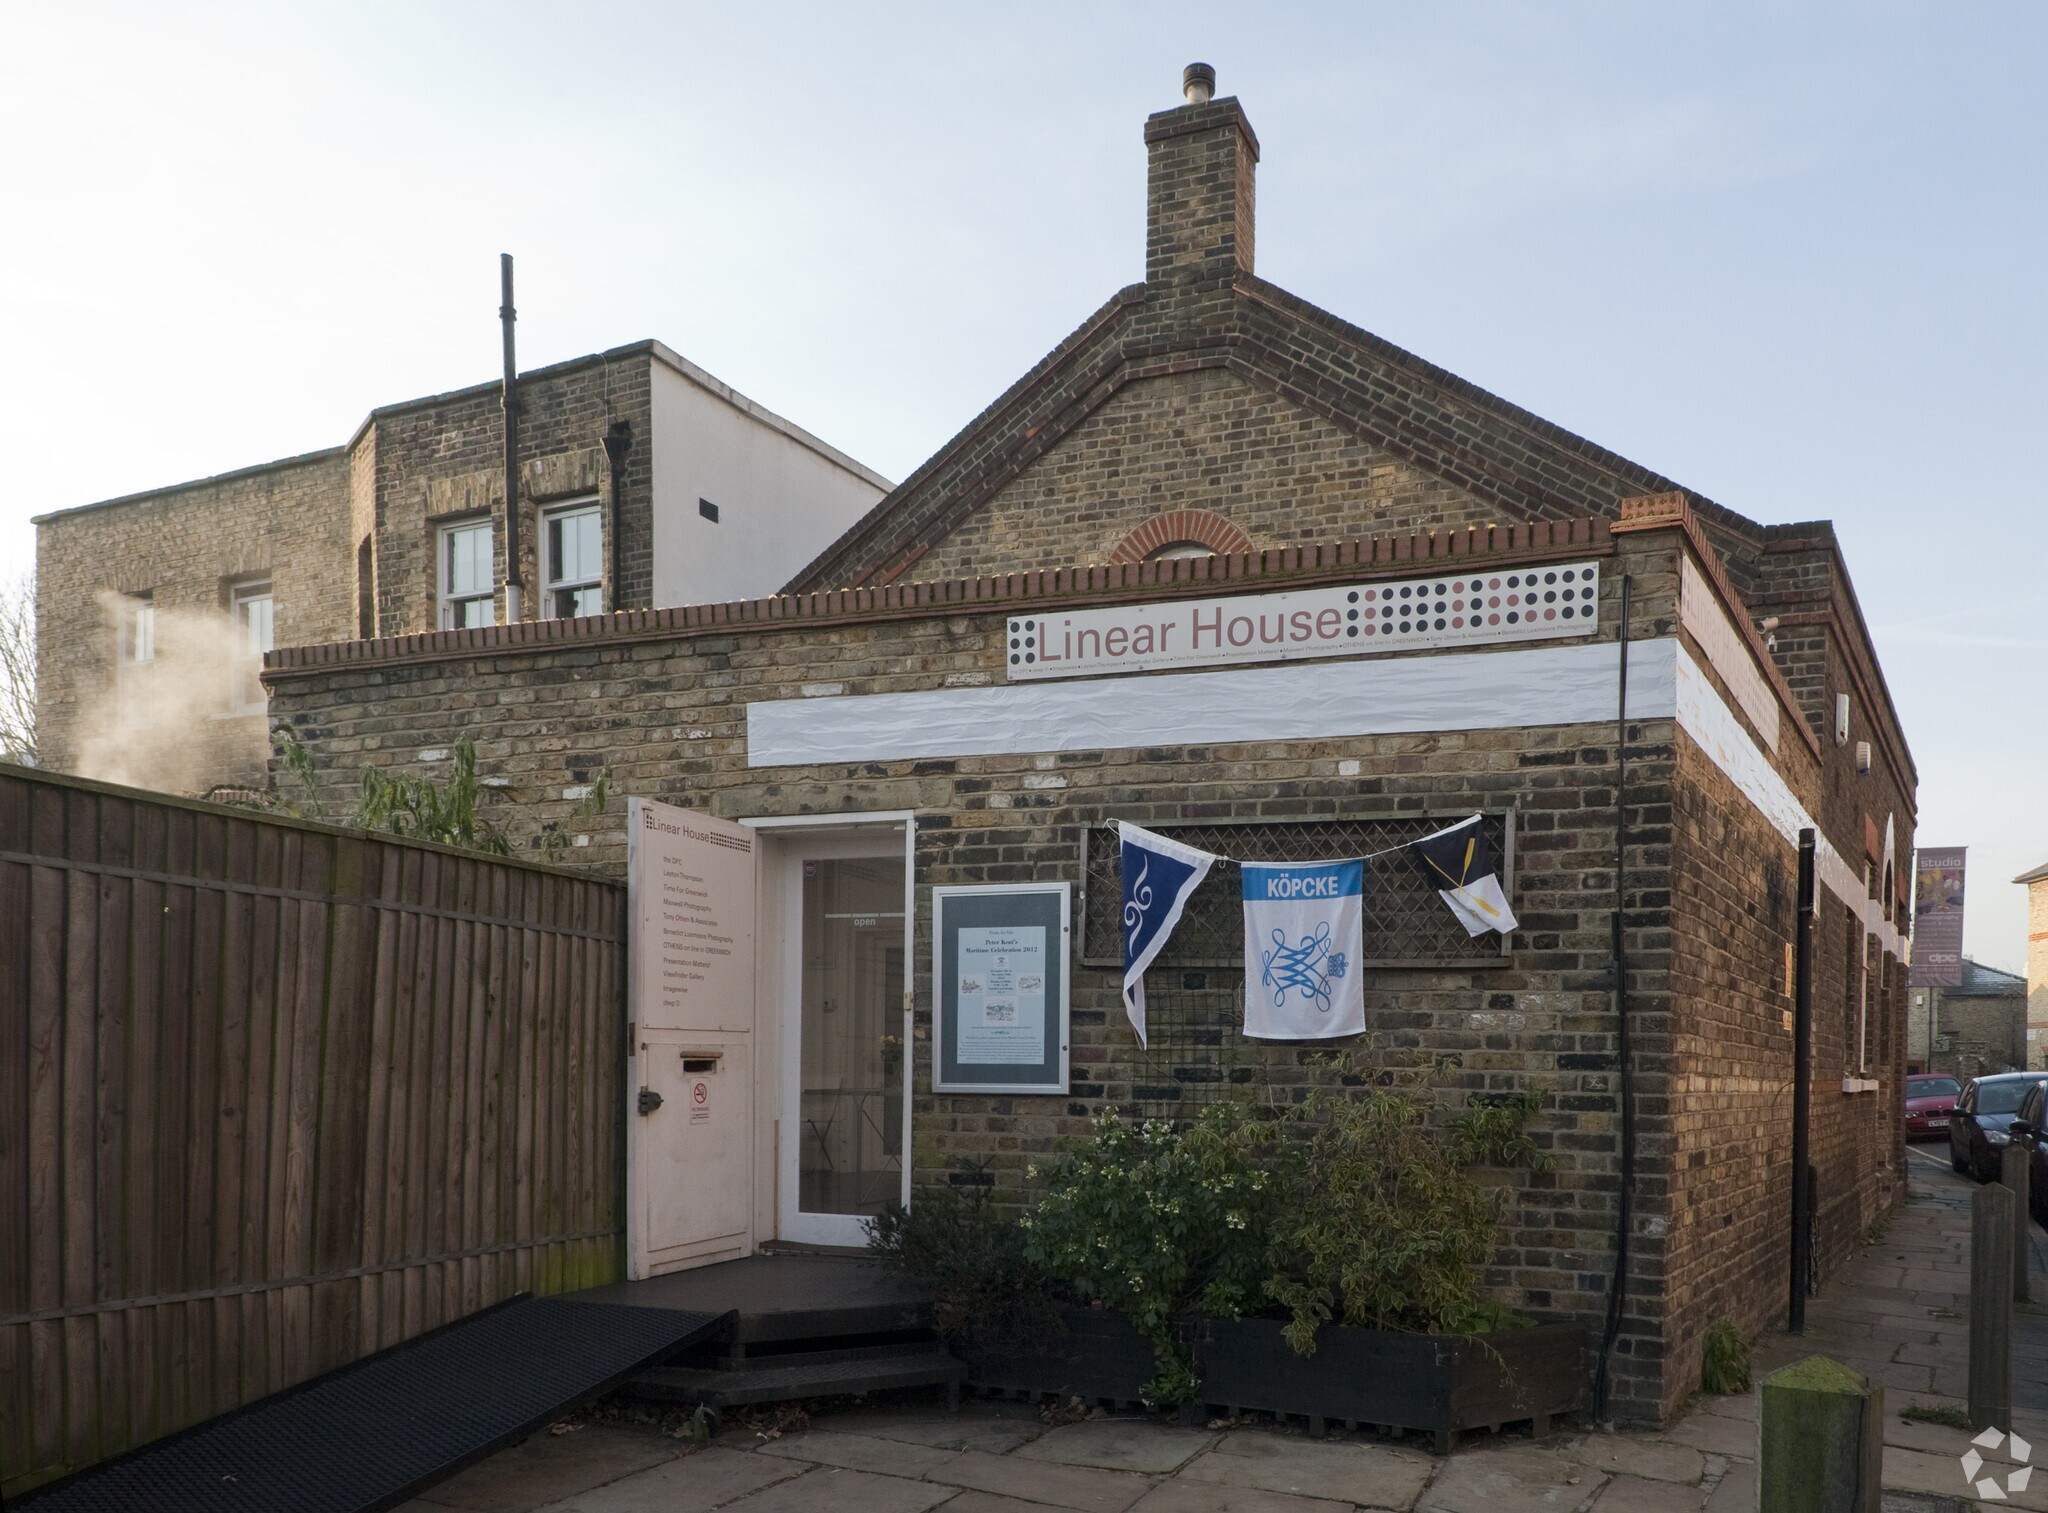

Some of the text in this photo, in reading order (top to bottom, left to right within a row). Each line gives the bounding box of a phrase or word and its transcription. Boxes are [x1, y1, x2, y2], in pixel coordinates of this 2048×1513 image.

[1039, 607, 1342, 662] Linear House
[652, 818, 710, 842] Linear House
[1920, 857, 1961, 868] studio
[1267, 872, 1339, 898] KÖPCKE
[854, 917, 876, 927] open
[663, 927, 684, 936] Benedict
